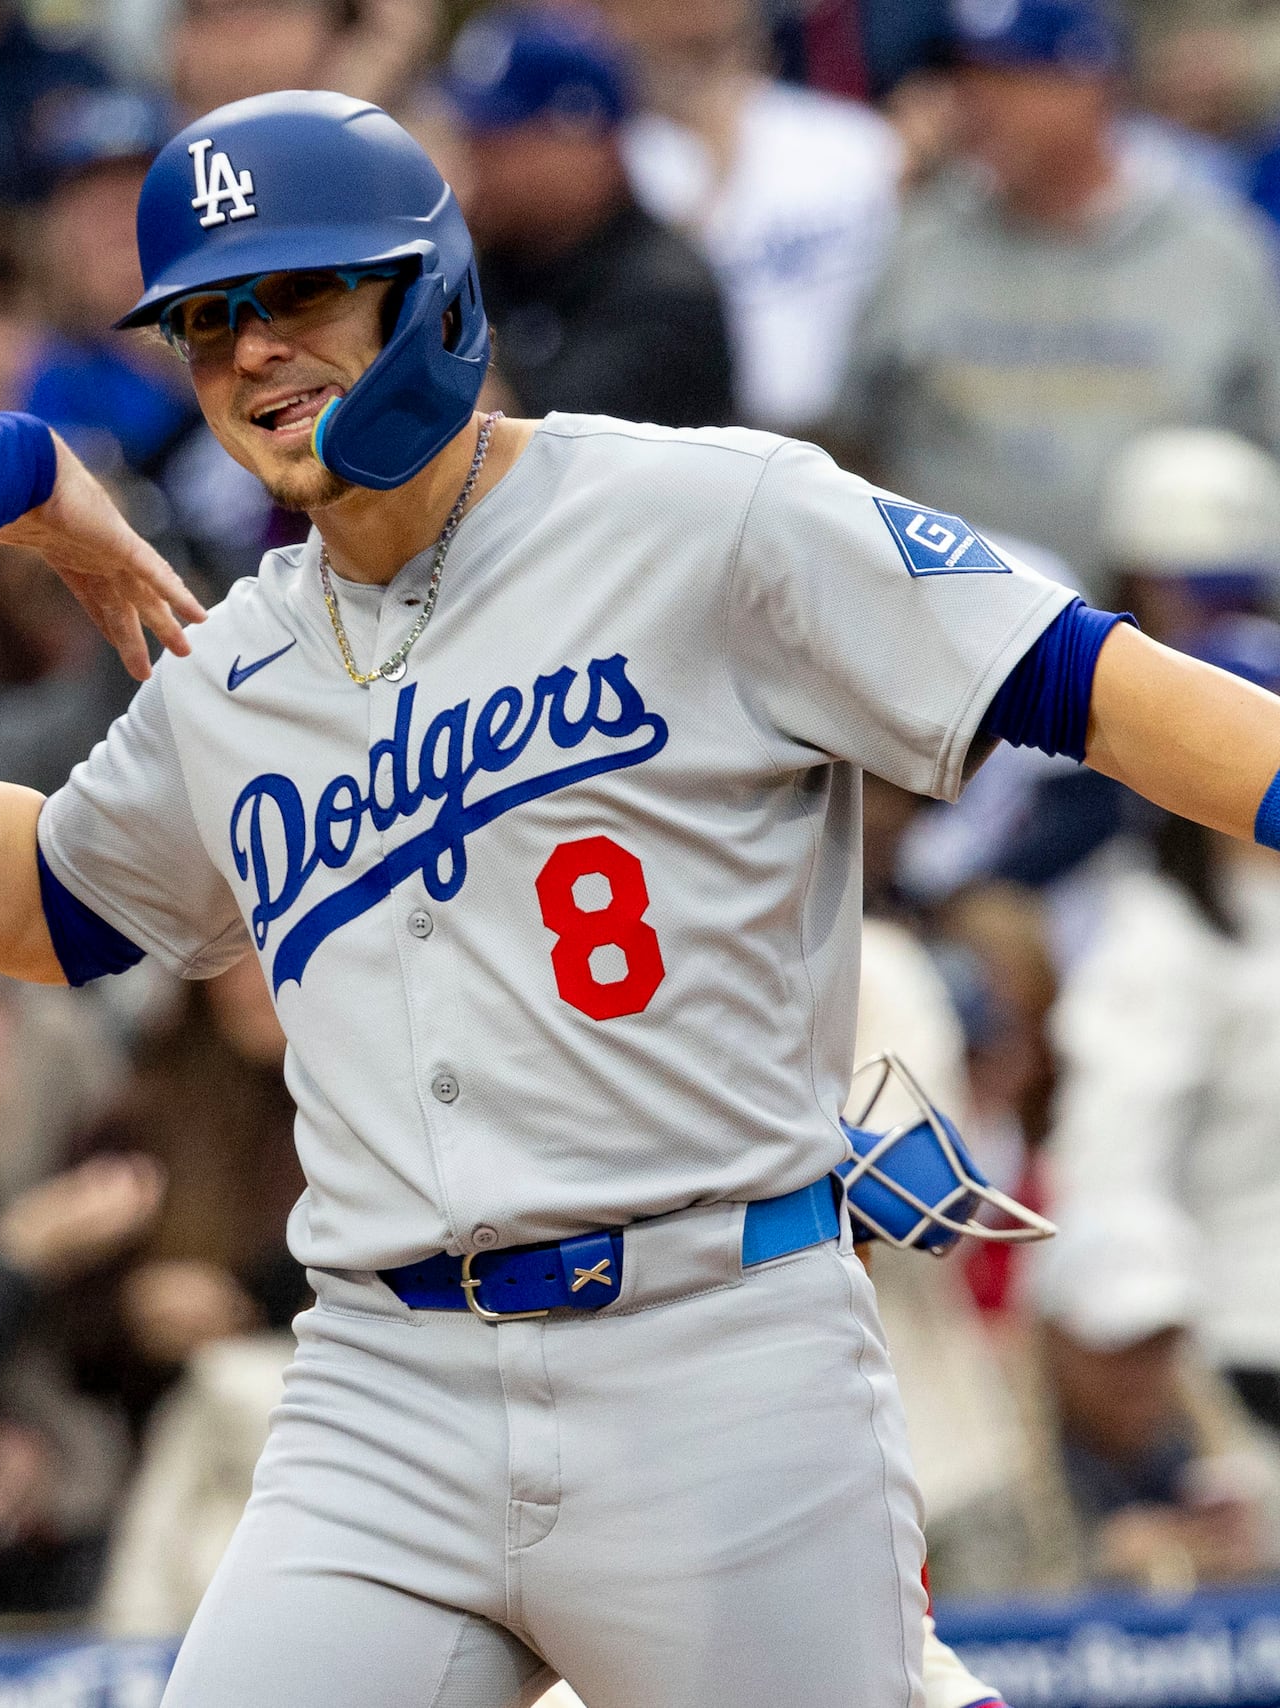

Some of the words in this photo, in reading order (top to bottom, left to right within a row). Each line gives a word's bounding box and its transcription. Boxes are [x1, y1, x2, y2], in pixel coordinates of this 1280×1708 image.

[187, 137, 256, 228] LA
[229, 652, 669, 960] Dodgers
[534, 834, 666, 1022] 8
